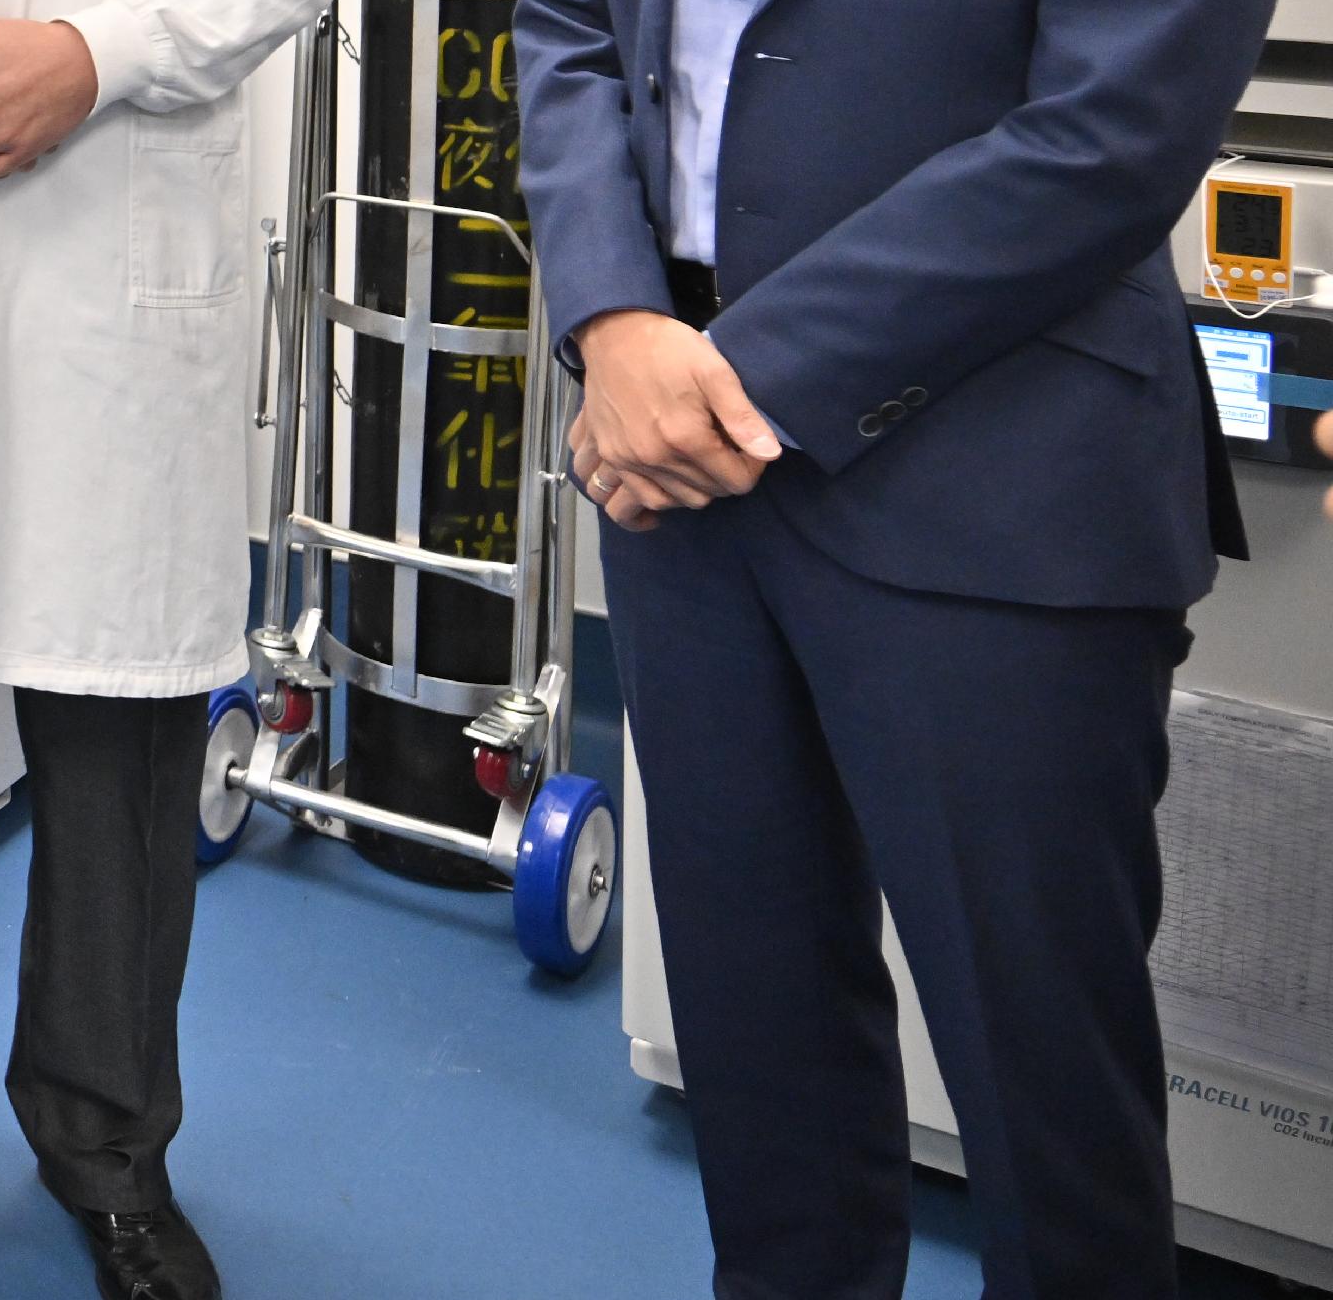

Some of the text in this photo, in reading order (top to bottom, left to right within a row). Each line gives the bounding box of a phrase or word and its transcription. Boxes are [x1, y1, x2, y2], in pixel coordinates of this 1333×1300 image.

[1165, 1071, 1333, 1136] RACELL VIOS 1
[1273, 1122, 1333, 1148] CO2 Incu
